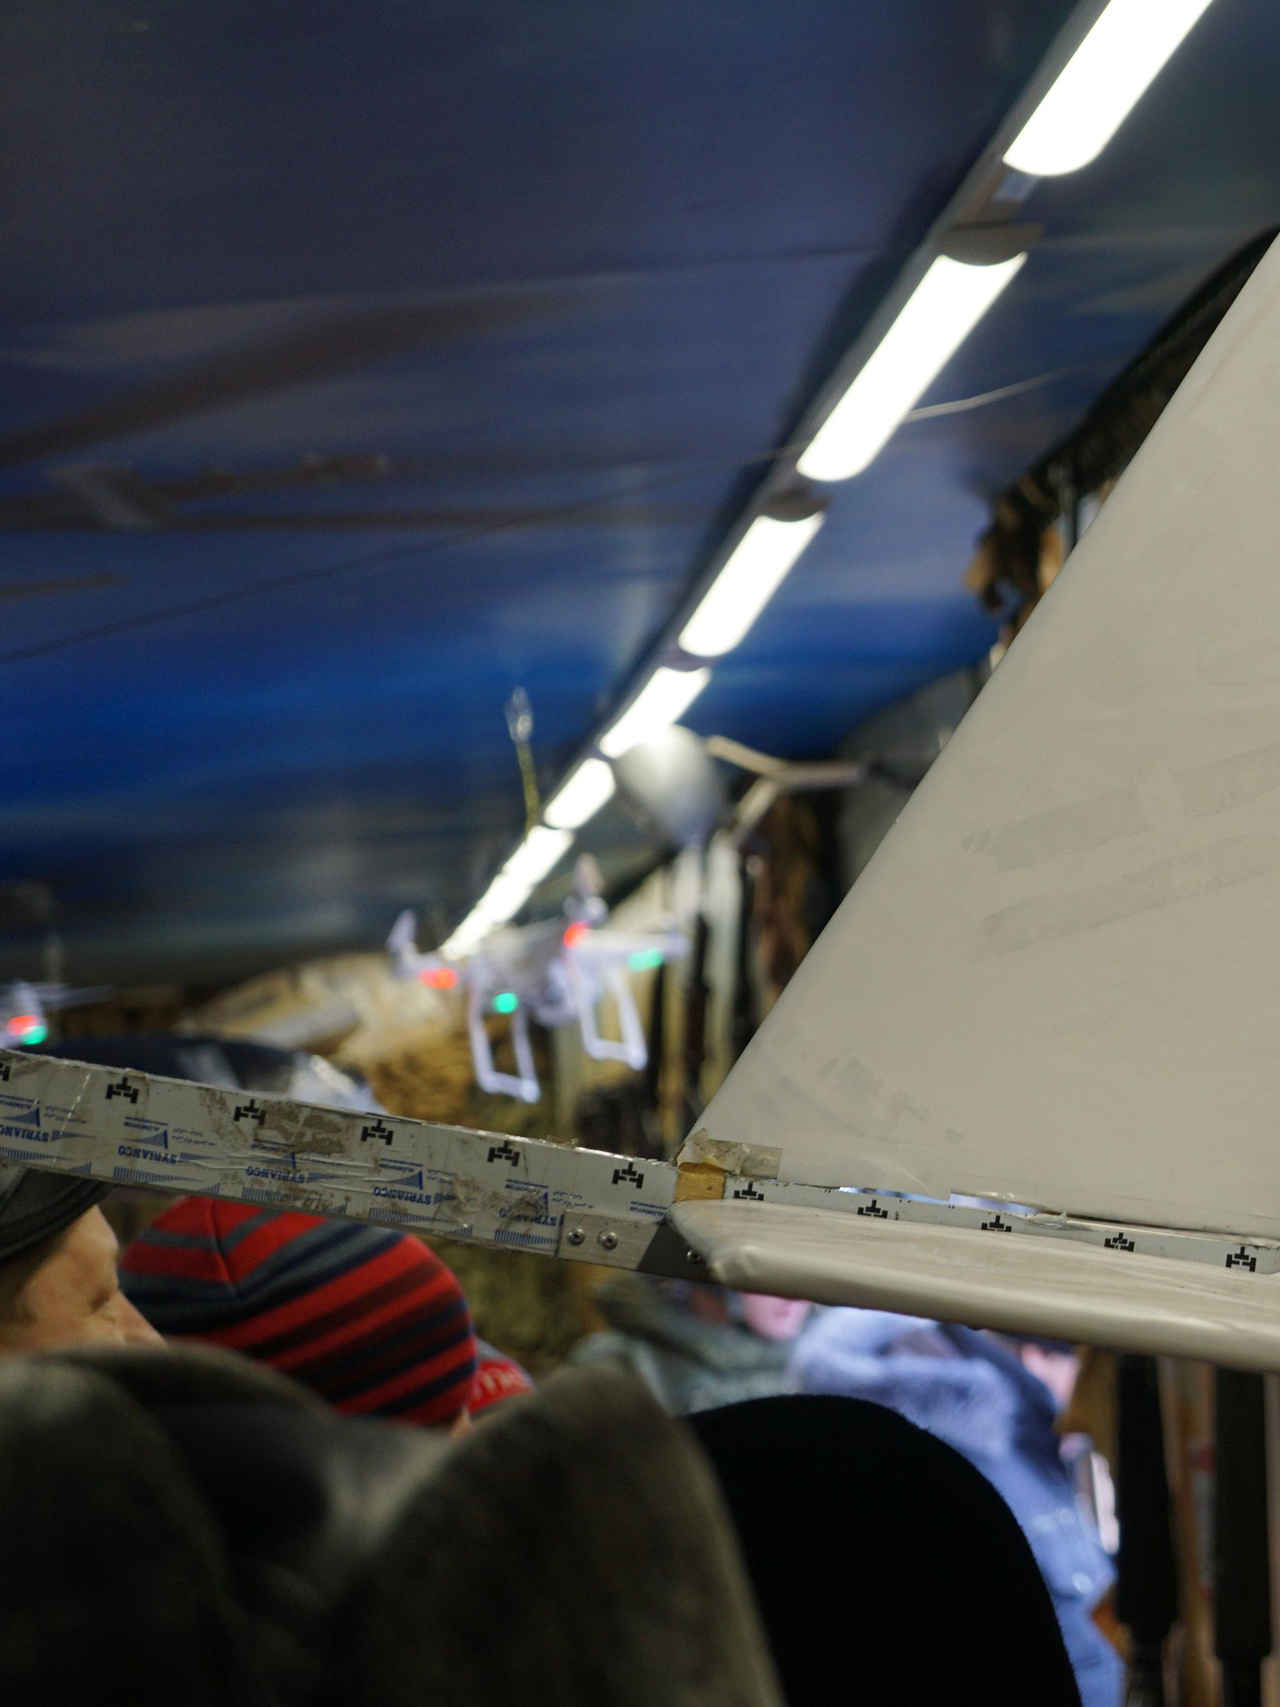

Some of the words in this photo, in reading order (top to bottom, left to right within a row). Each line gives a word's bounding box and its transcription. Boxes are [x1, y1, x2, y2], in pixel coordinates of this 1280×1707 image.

[0, 1123, 49, 1142] SYRIANC
[118, 1145, 177, 1164] SYRIANCO
[246, 1166, 305, 1184] SYRIANCO
[373, 1186, 432, 1205] SYRIANCO
